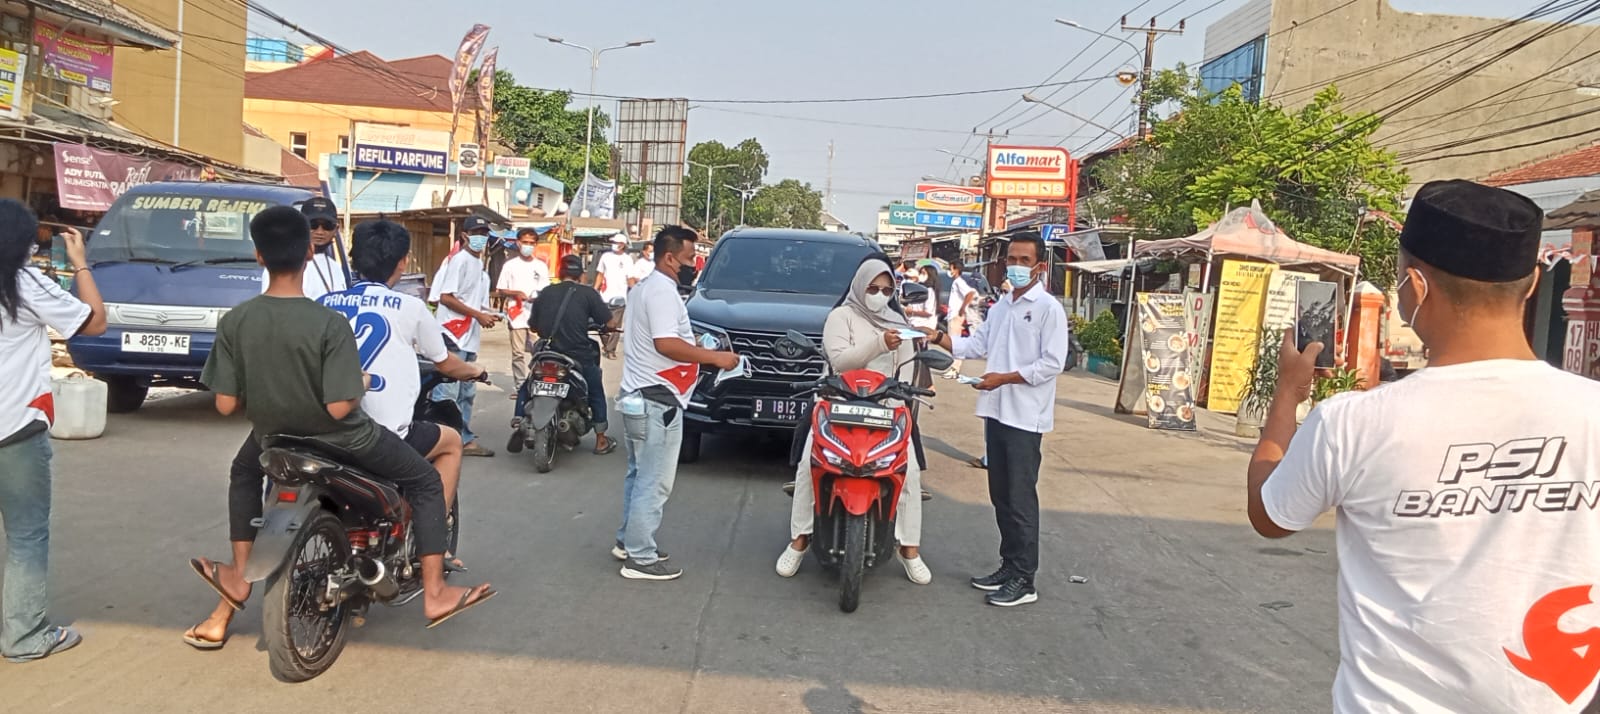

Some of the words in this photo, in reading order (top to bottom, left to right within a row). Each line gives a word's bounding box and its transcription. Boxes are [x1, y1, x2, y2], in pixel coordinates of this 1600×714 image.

[359, 148, 392, 164] REFILL
[395, 152, 443, 169] PARFUME
[996, 152, 1061, 166] Alfamart
[132, 196, 202, 210] SUMBER
[893, 211, 914, 219] opp
[382, 296, 401, 310] KA
[124, 334, 130, 344] A
[142, 335, 167, 346] 8259
[175, 336, 188, 348] KE
[1570, 323, 1583, 346] 17
[1566, 348, 1581, 369] 08
[756, 400, 763, 412] B
[773, 400, 796, 414] 1812
[1437, 436, 1568, 484] PSI
[1393, 481, 1600, 517] BANTEN
